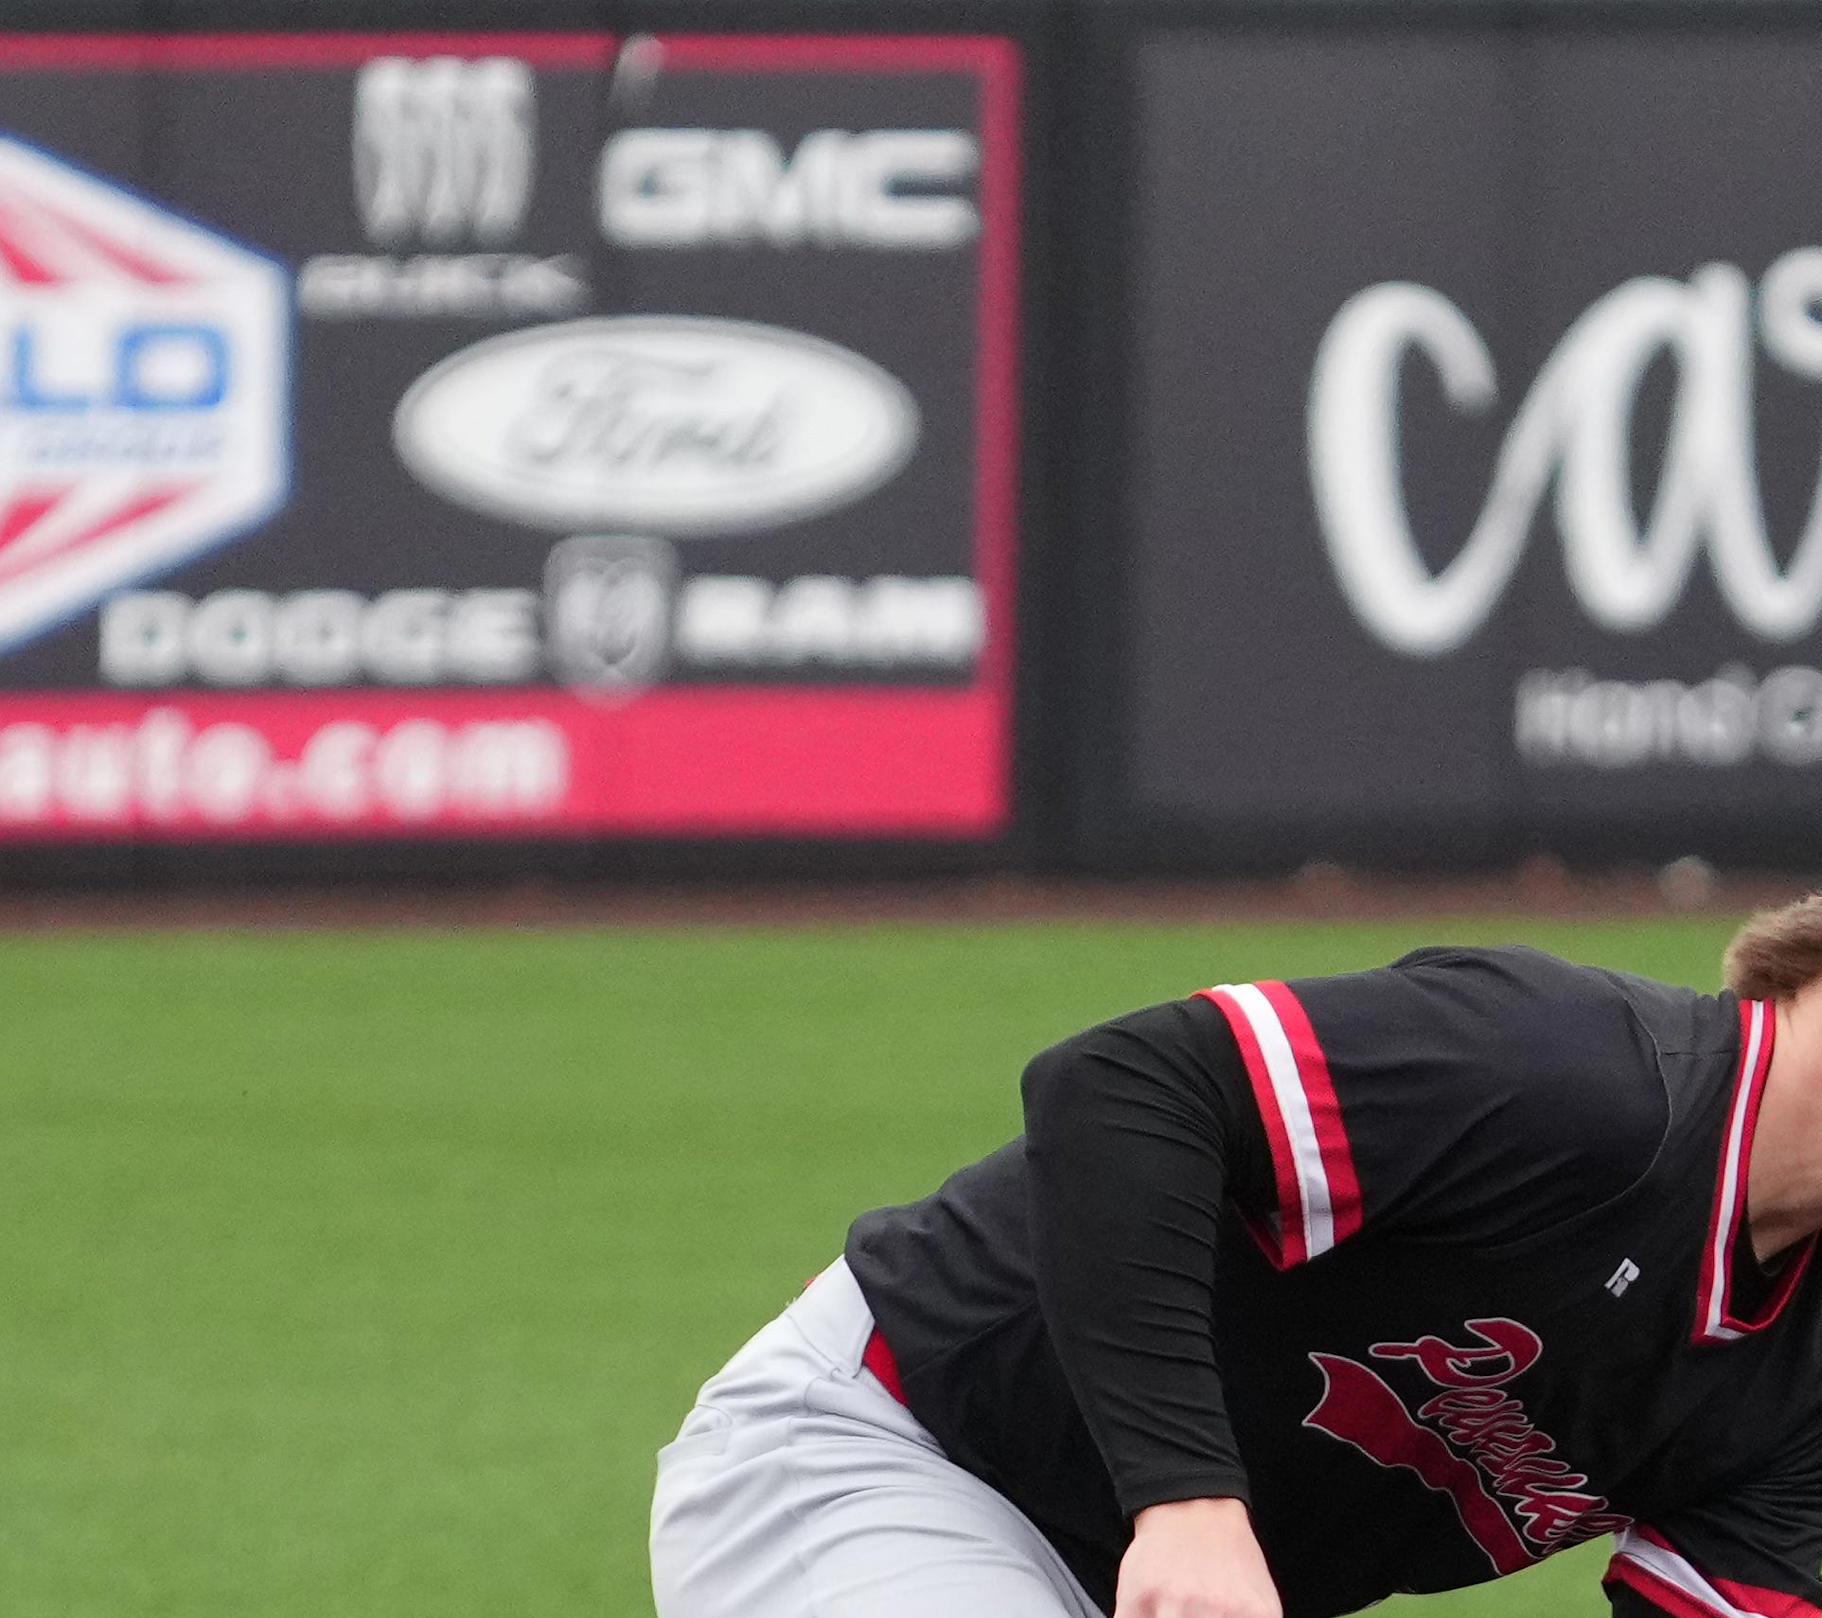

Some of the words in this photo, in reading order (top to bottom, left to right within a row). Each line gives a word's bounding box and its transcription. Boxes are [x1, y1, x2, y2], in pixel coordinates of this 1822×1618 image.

[601, 128, 981, 248] GMC
[503, 350, 797, 468] Ford
[100, 590, 542, 686] DODGE
[677, 575, 984, 667] RAM
[1516, 662, 1754, 764] Hand
